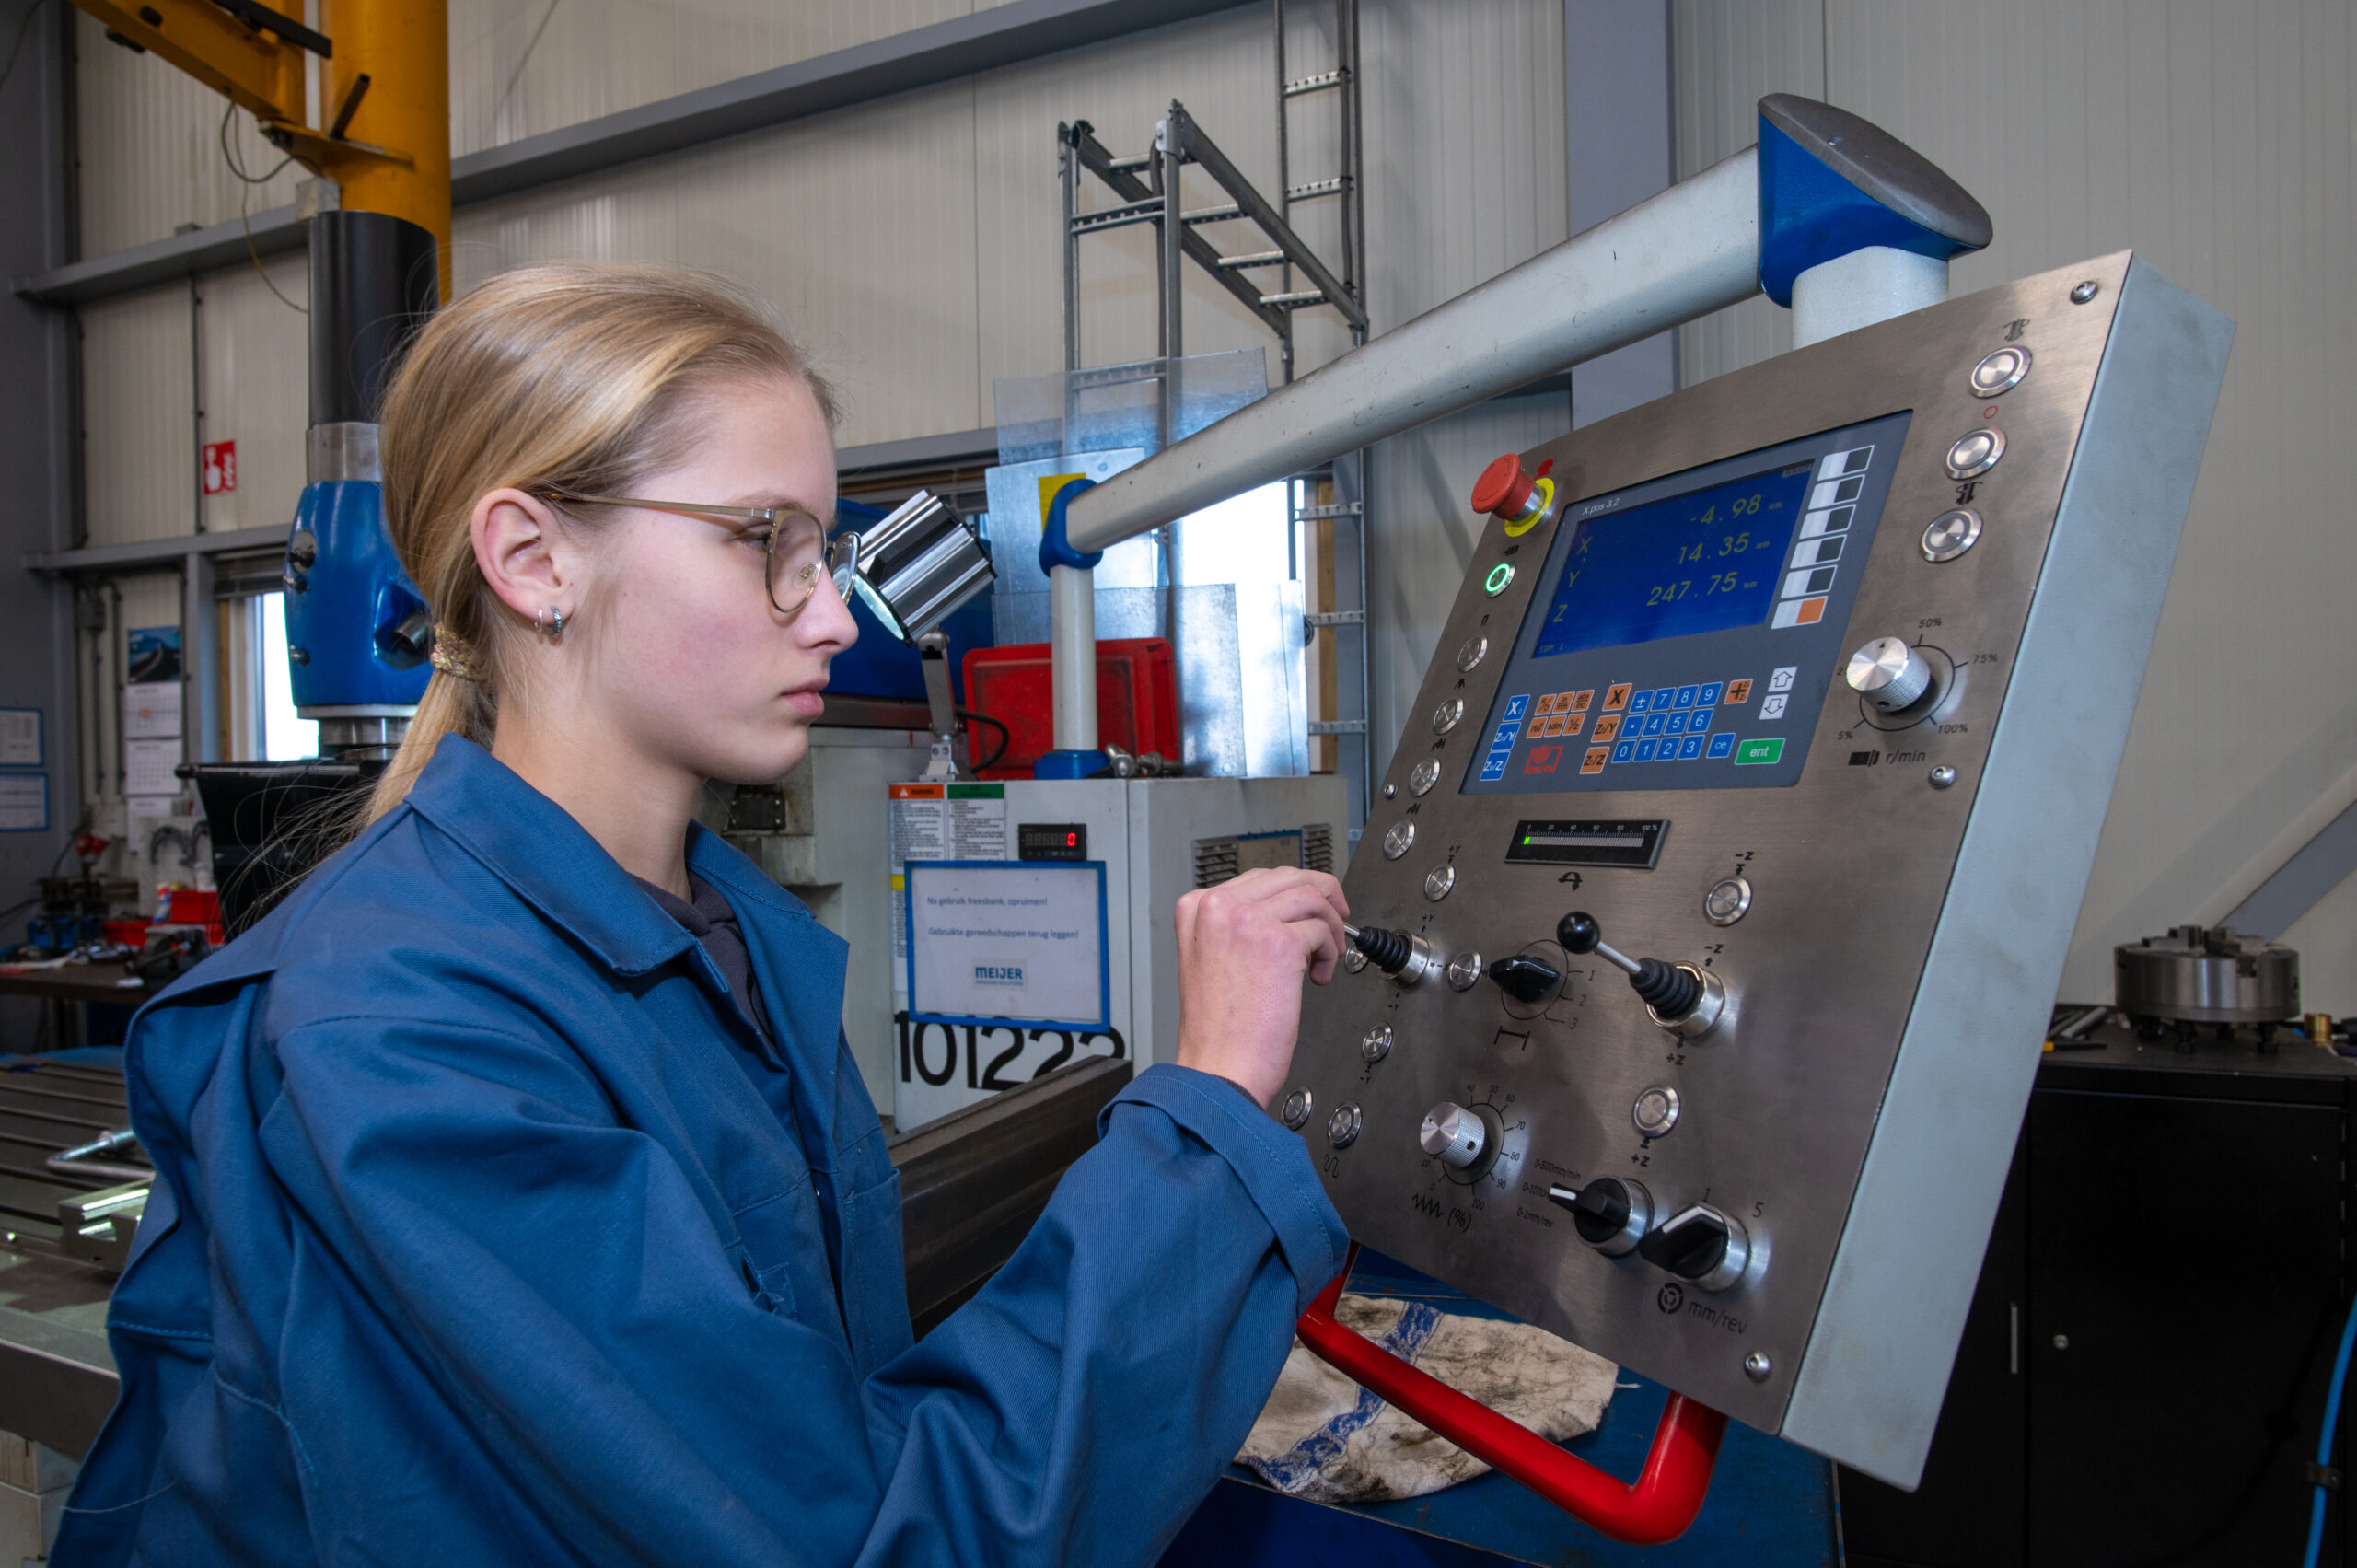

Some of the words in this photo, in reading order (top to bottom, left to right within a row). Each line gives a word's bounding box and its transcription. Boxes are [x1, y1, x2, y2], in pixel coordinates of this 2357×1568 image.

[1606, 497, 1620, 508] 3.2
[1576, 536, 1593, 555] X
[1679, 532, 1750, 564] 14.35
[1569, 571, 1580, 587] Y
[1646, 572, 1737, 607] 247.75
[1553, 604, 1568, 622] Z
[1918, 618, 1943, 628] 50%
[1972, 653, 1998, 664] 75%
[1609, 691, 1624, 705] X
[1659, 694, 1668, 705] 7
[1681, 691, 1689, 703] 8
[1704, 688, 1713, 701] 9
[1650, 720, 1658, 730] 4
[1672, 716, 1680, 728] 5
[1695, 715, 1704, 726] 6
[1531, 722, 1543, 732] ref
[1938, 724, 1968, 734] 100%
[1838, 730, 1852, 740] 5%
[1643, 745, 1649, 756] 1
[1663, 743, 1673, 754] 2
[1686, 741, 1695, 753] 3
[1714, 741, 1726, 749] ce
[1620, 745, 1628, 757] 0
[1749, 746, 1770, 757] ent
[1885, 749, 1926, 764] r/min
[1524, 766, 1556, 774] KNUTH
[1067, 832, 1076, 847] 0
[1736, 851, 1755, 861] -Z
[927, 897, 937, 905] Na
[939, 897, 966, 906] gebruik
[968, 897, 1006, 906] freesbank,
[1007, 898, 1048, 907] opruimen!
[928, 928, 963, 936] Gebruikte
[965, 928, 1026, 938] gereedschappen
[1028, 930, 1049, 939] terug
[1050, 930, 1079, 939] leggen!
[1704, 944, 1724, 954] -Z
[975, 967, 1023, 980] MEIJER
[1588, 970, 1596, 981] 1
[1578, 994, 1586, 1006] 2
[1570, 1017, 1578, 1030] 3
[1666, 1053, 1686, 1065] +Z
[1506, 1094, 1515, 1103] 60
[1515, 1121, 1526, 1130] 70
[1510, 1152, 1520, 1161] 80
[1631, 1154, 1650, 1167] +Z
[1534, 1159, 1581, 1179] 0-500mm/min
[1497, 1179, 1506, 1189] 90
[1702, 1188, 1711, 1202] 1
[1472, 1199, 1485, 1210] 100
[1753, 1202, 1764, 1218] 5
[1448, 1207, 1472, 1233] (%)
[1689, 1301, 1747, 1334] mm/rev
